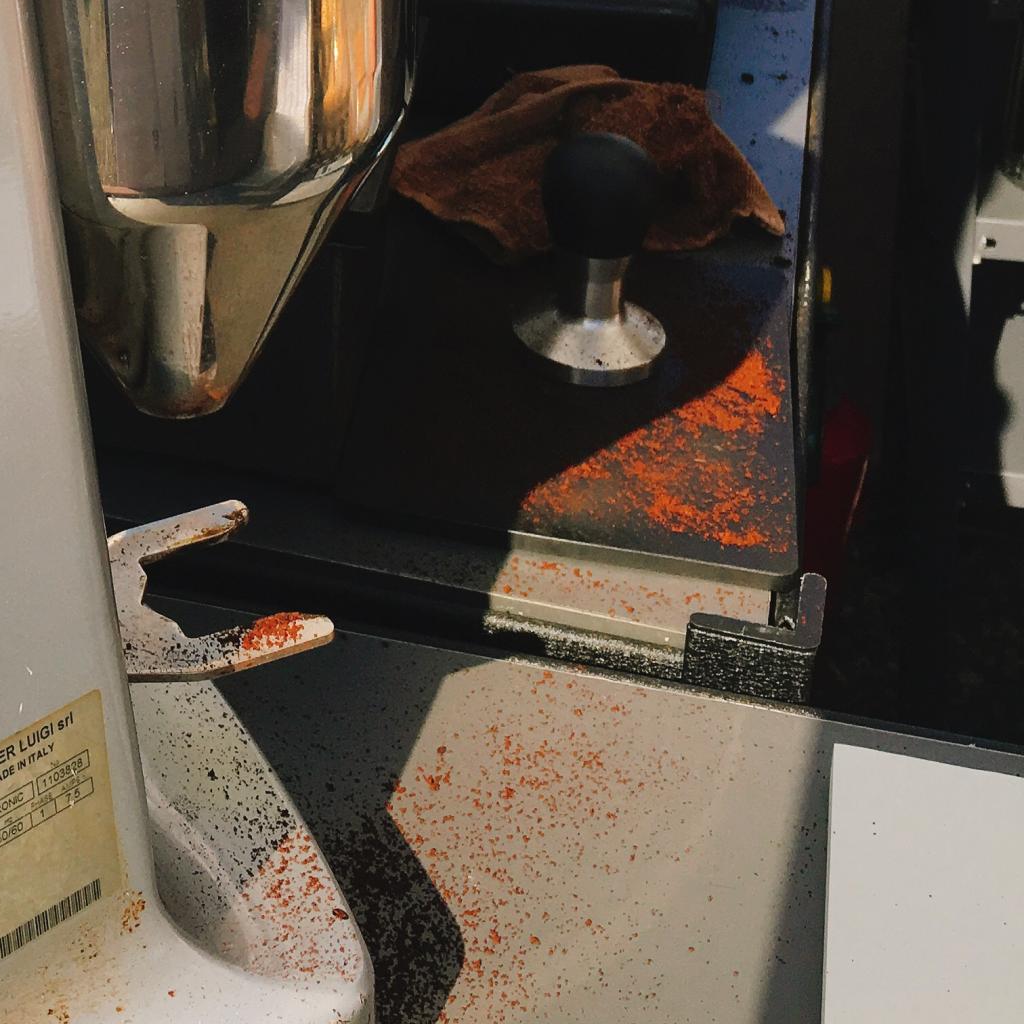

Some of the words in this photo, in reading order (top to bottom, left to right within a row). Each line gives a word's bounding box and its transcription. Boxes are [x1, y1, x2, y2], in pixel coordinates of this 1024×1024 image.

[18, 722, 54, 753] LUIGI
[56, 711, 73, 731] srl
[17, 758, 27, 770] IN
[27, 742, 54, 764] ITALY
[64, 786, 80, 804] 75
[39, 807, 44, 818] 1
